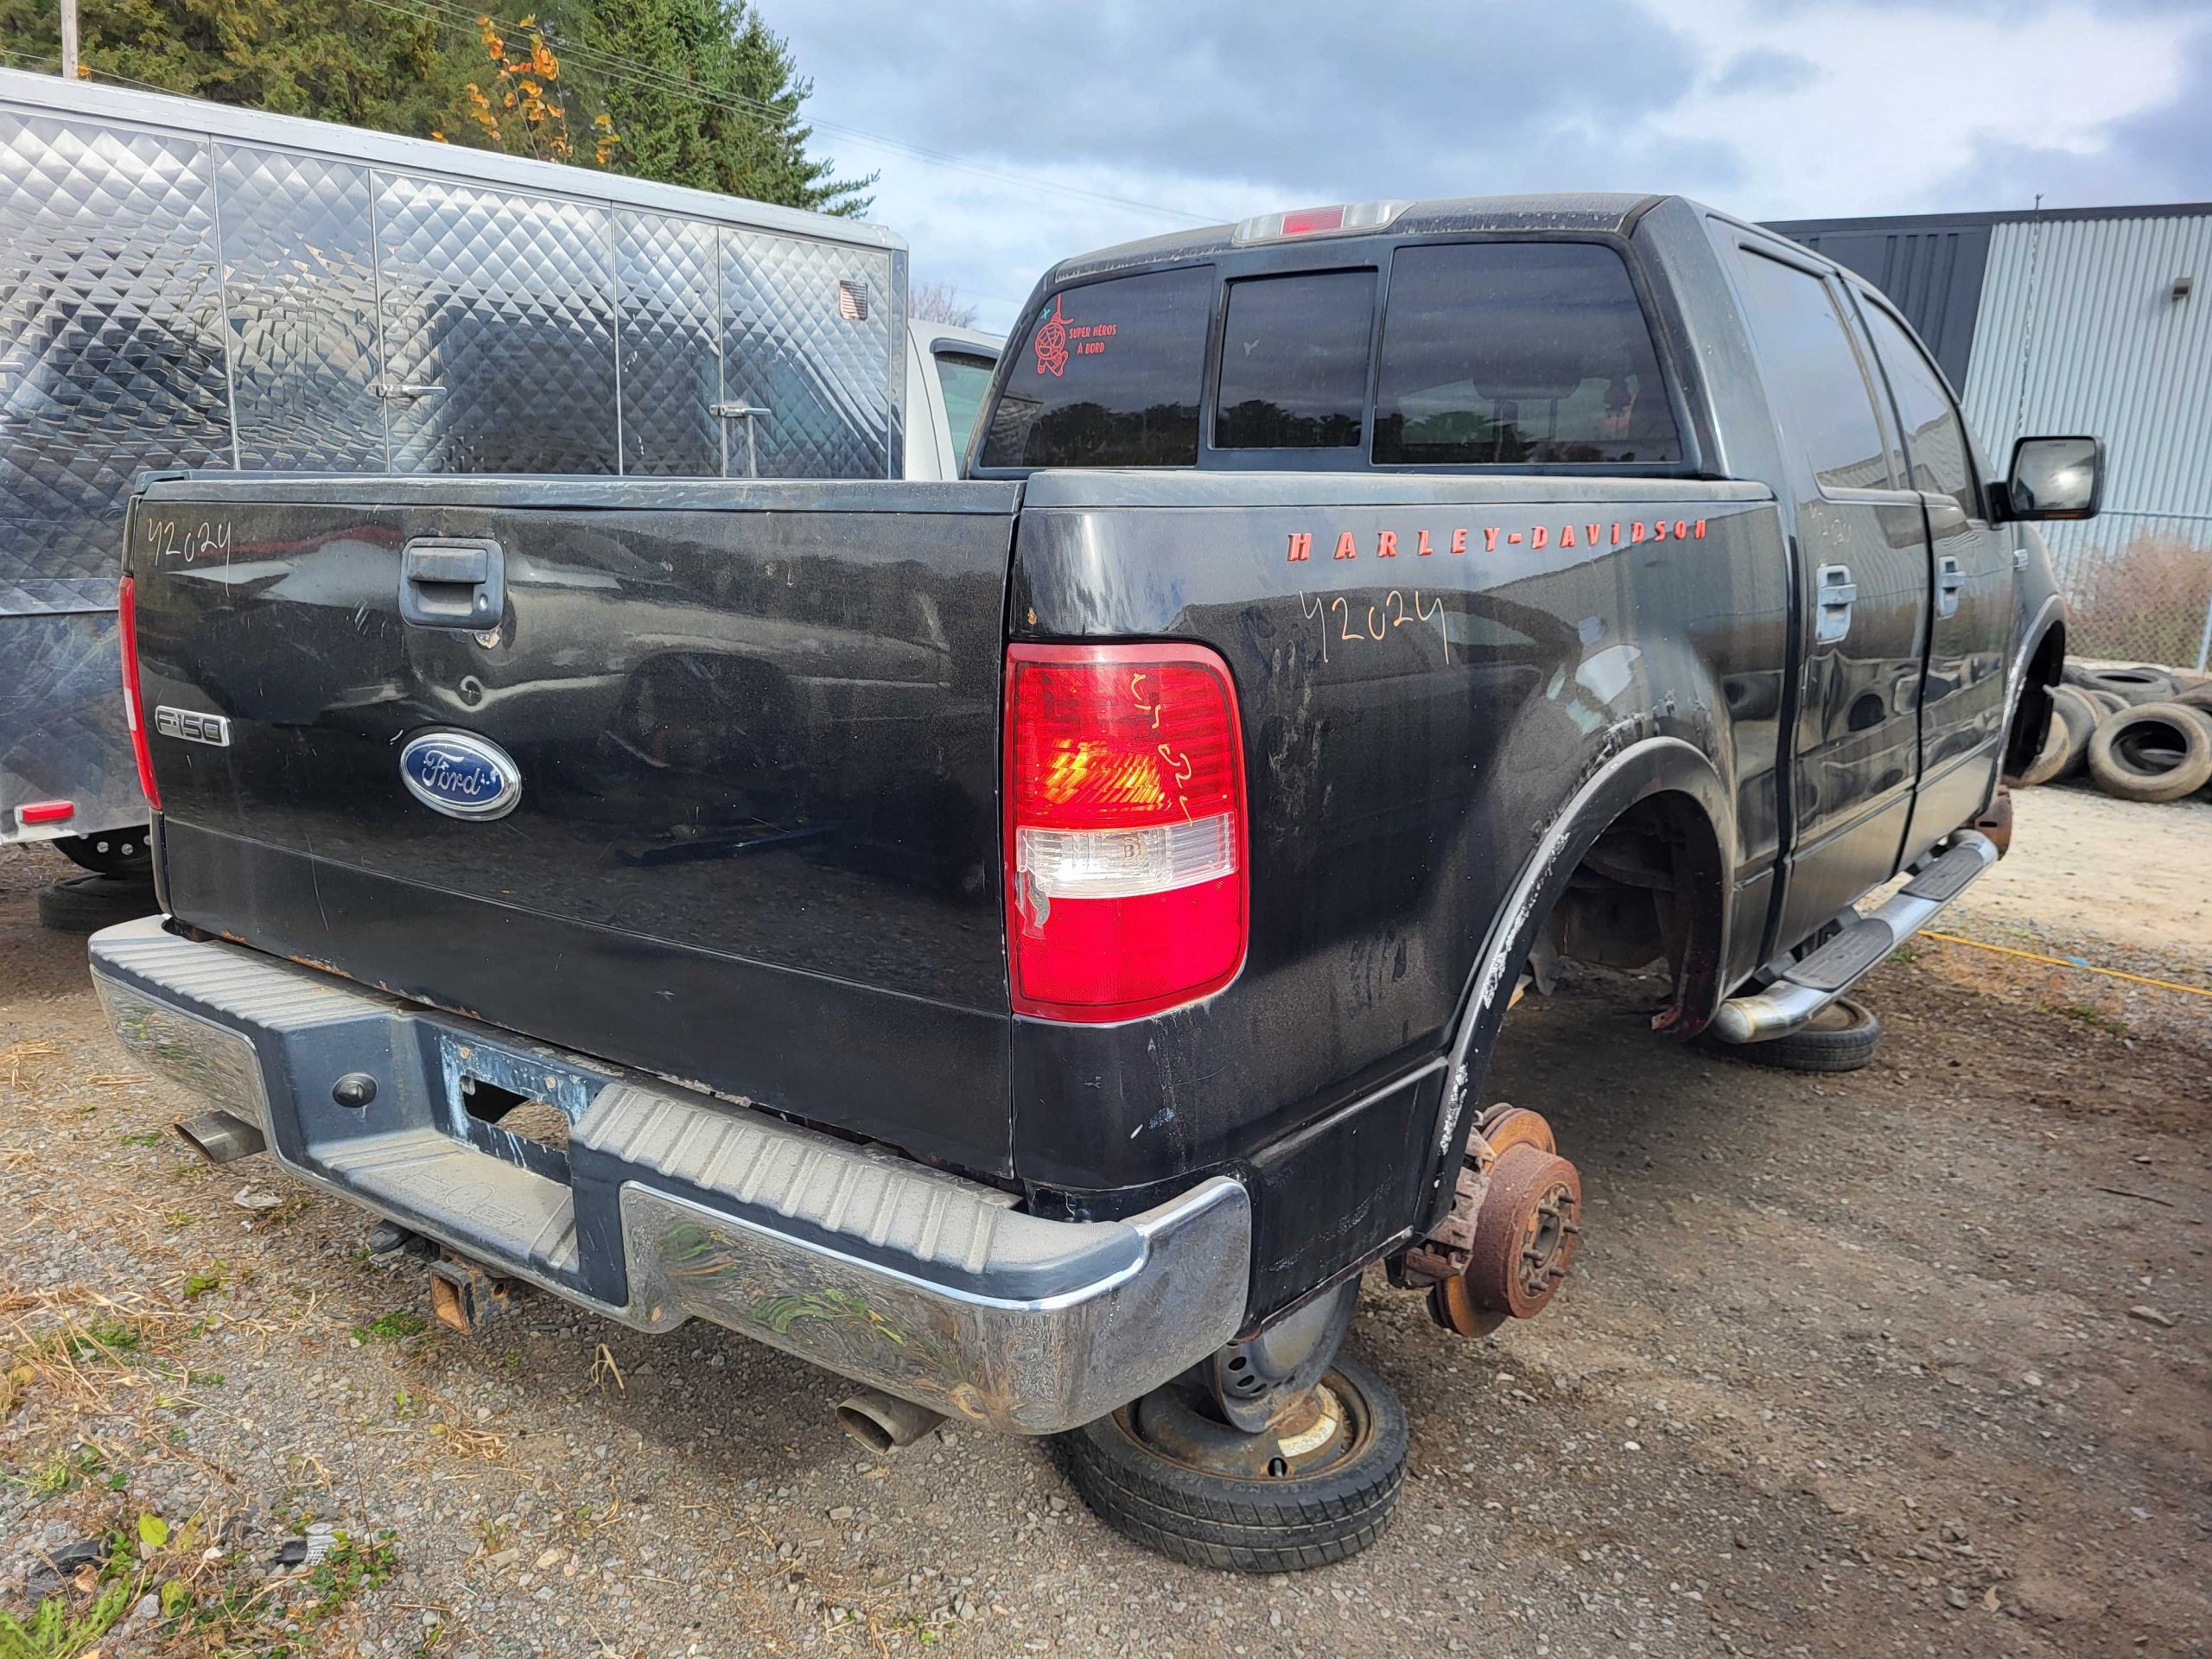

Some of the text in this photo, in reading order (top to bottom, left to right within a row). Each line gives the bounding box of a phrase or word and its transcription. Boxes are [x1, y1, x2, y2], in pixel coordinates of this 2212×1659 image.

[1069, 323, 1116, 339] SUPER HÉROS
[1085, 342, 1105, 354] BORD
[1287, 519, 1707, 562] HARLEY-DAVIDSON
[422, 749, 482, 796] Ford
